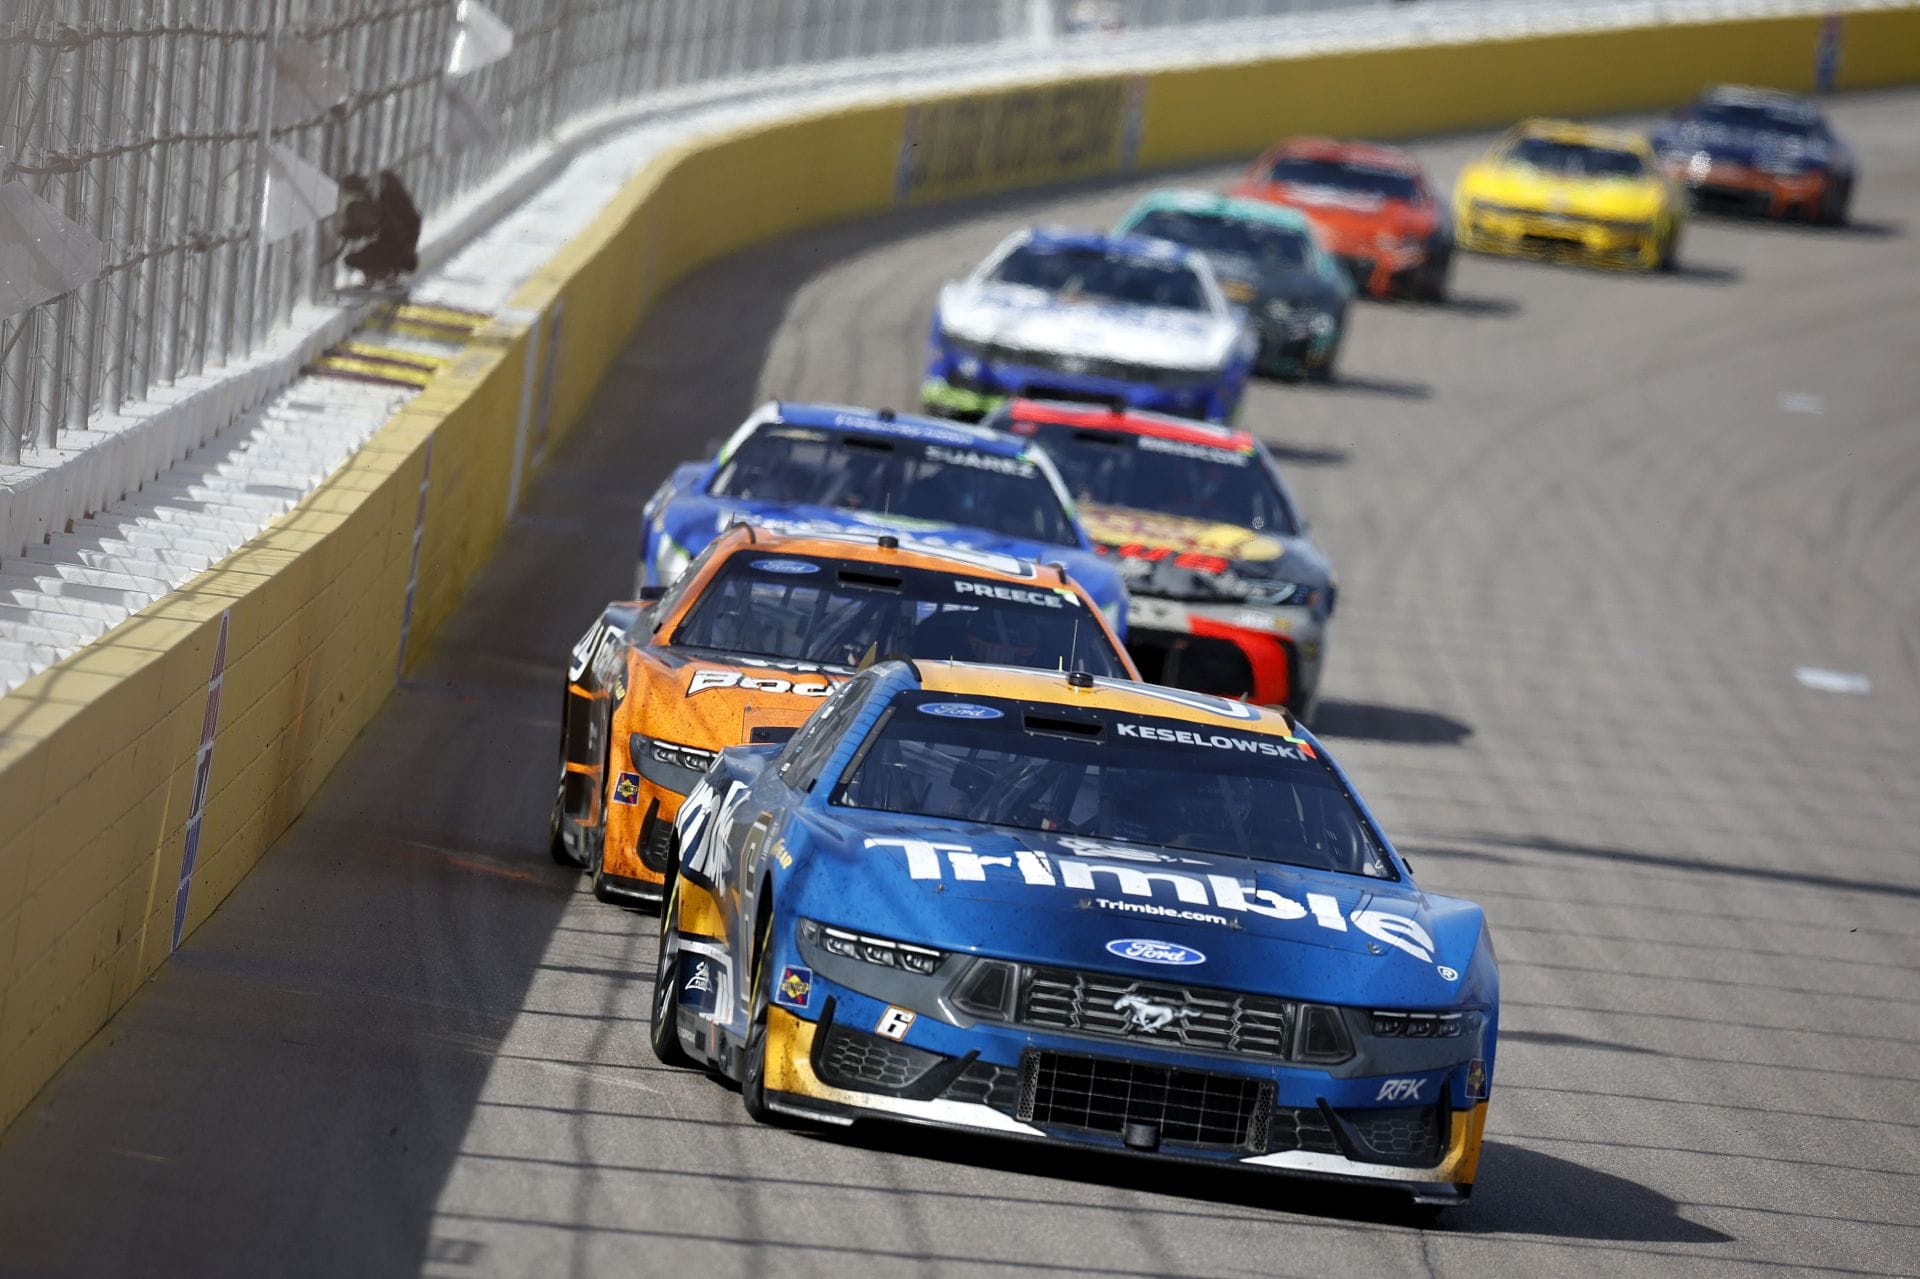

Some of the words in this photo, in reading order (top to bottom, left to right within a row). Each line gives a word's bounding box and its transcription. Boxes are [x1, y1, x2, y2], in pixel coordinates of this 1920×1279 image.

[953, 580, 1063, 609] PREECE
[1116, 722, 1309, 761] KESELOWSKI
[864, 837, 1436, 962] Trimble
[1095, 898, 1228, 926] Trimble.com
[1125, 941, 1187, 963] Ford
[876, 1005, 916, 1041] 6
[1375, 1078, 1427, 1101] RFK
